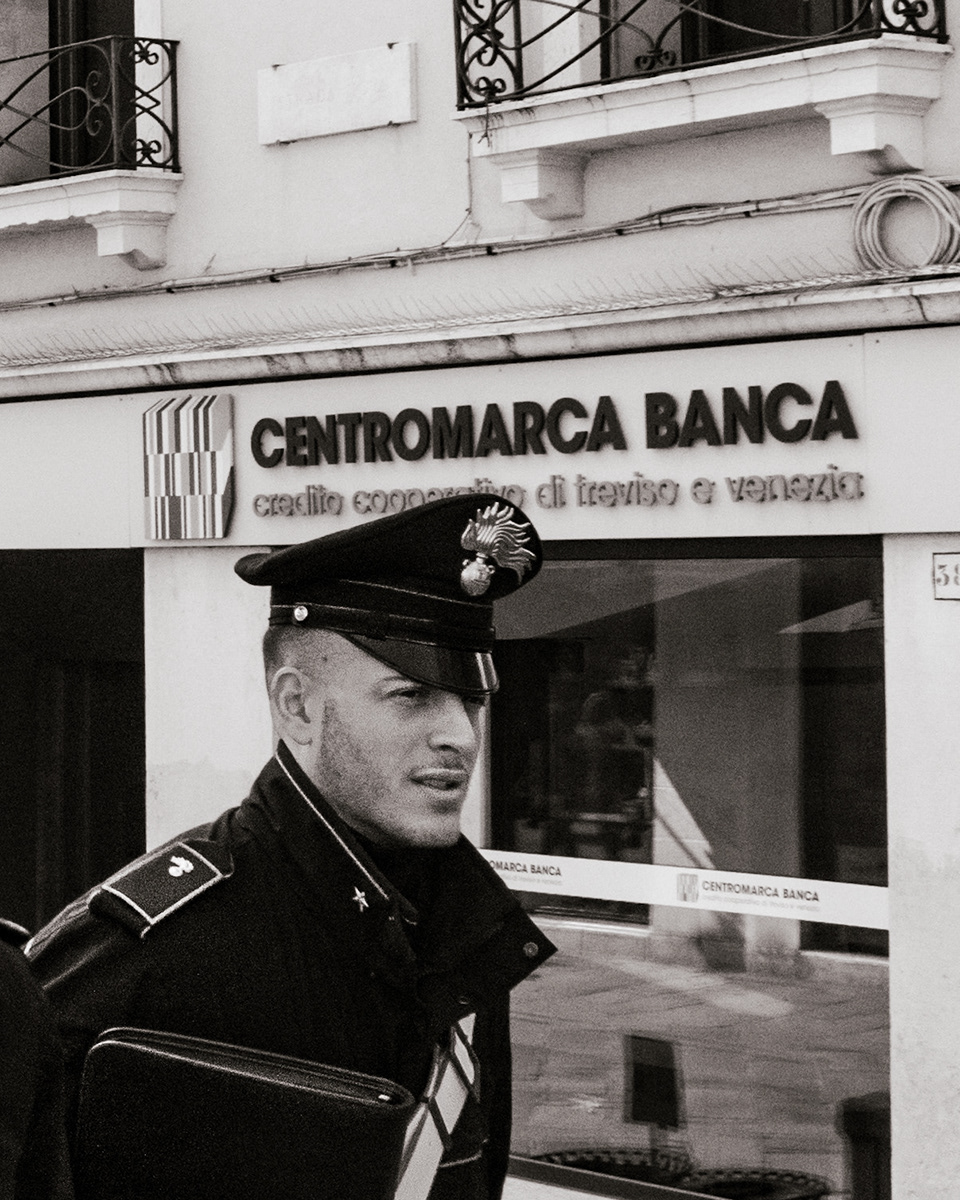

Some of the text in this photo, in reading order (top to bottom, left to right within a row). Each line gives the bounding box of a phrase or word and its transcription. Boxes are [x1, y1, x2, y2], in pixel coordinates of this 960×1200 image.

[251, 380, 860, 469] CENTROMARCA BANCA
[252, 484, 344, 518] credito
[535, 474, 567, 509] di
[574, 473, 680, 507] treviso
[691, 477, 716, 505] e
[725, 463, 864, 503] venezia
[529, 864, 563, 877] BANCA
[701, 880, 820, 902] CENTROMARCA BANCA
